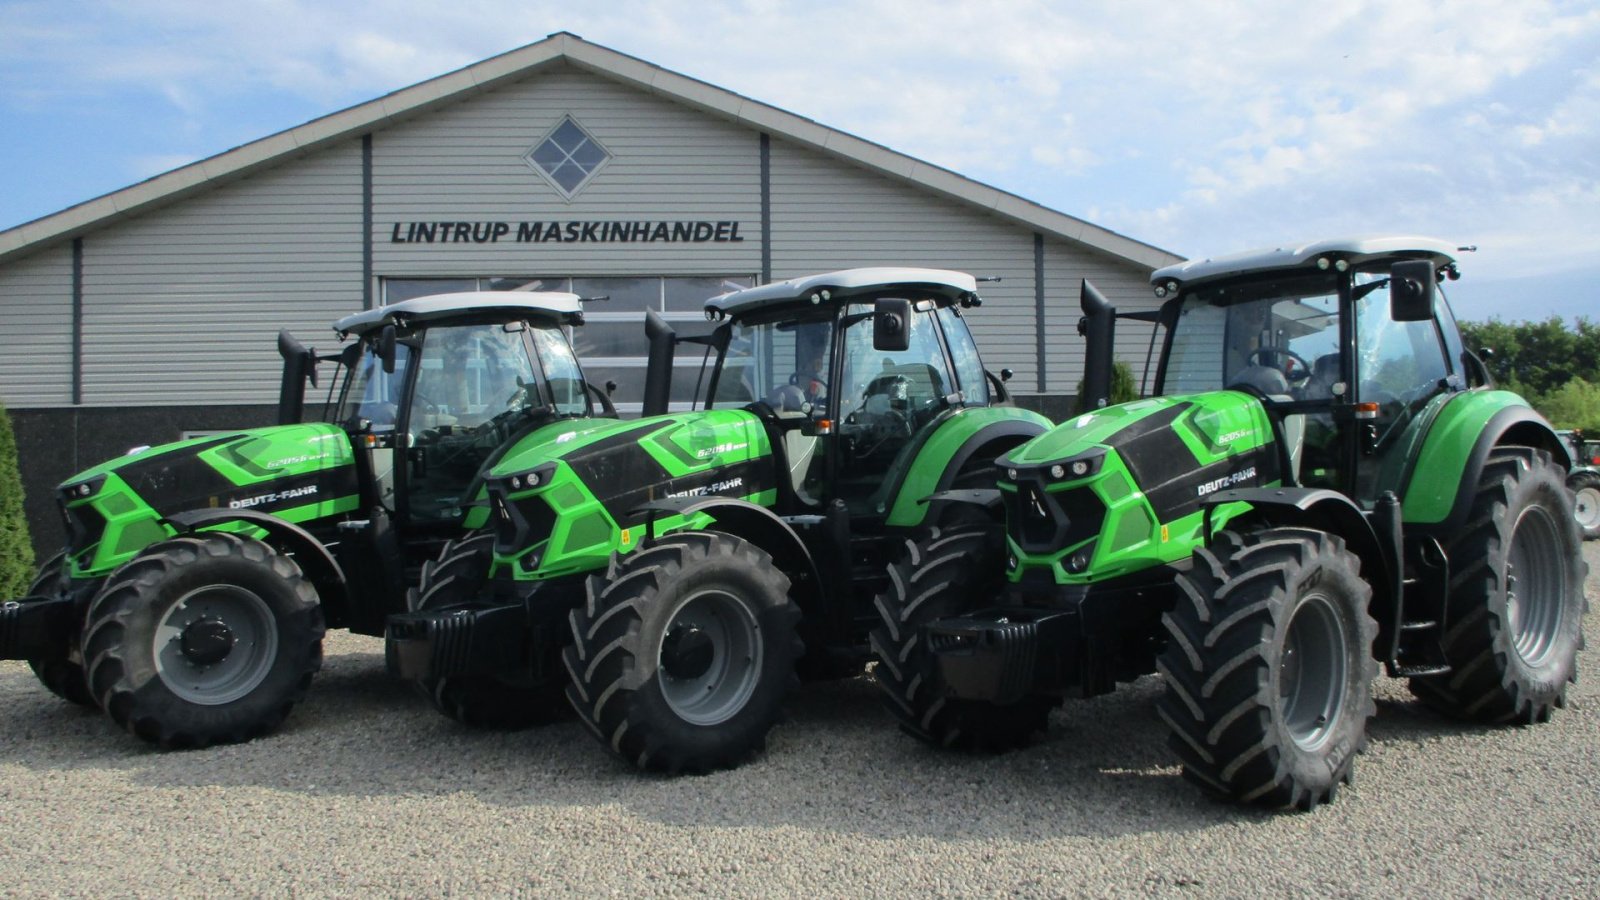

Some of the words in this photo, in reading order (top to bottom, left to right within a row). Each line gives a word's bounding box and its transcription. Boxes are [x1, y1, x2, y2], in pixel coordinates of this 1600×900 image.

[391, 221, 509, 243] LINTRUP
[516, 221, 744, 243] MASKINHANDEL
[1197, 466, 1256, 496] DEUTZ-FAHR
[229, 484, 318, 509] DEUTZ-FAHR
